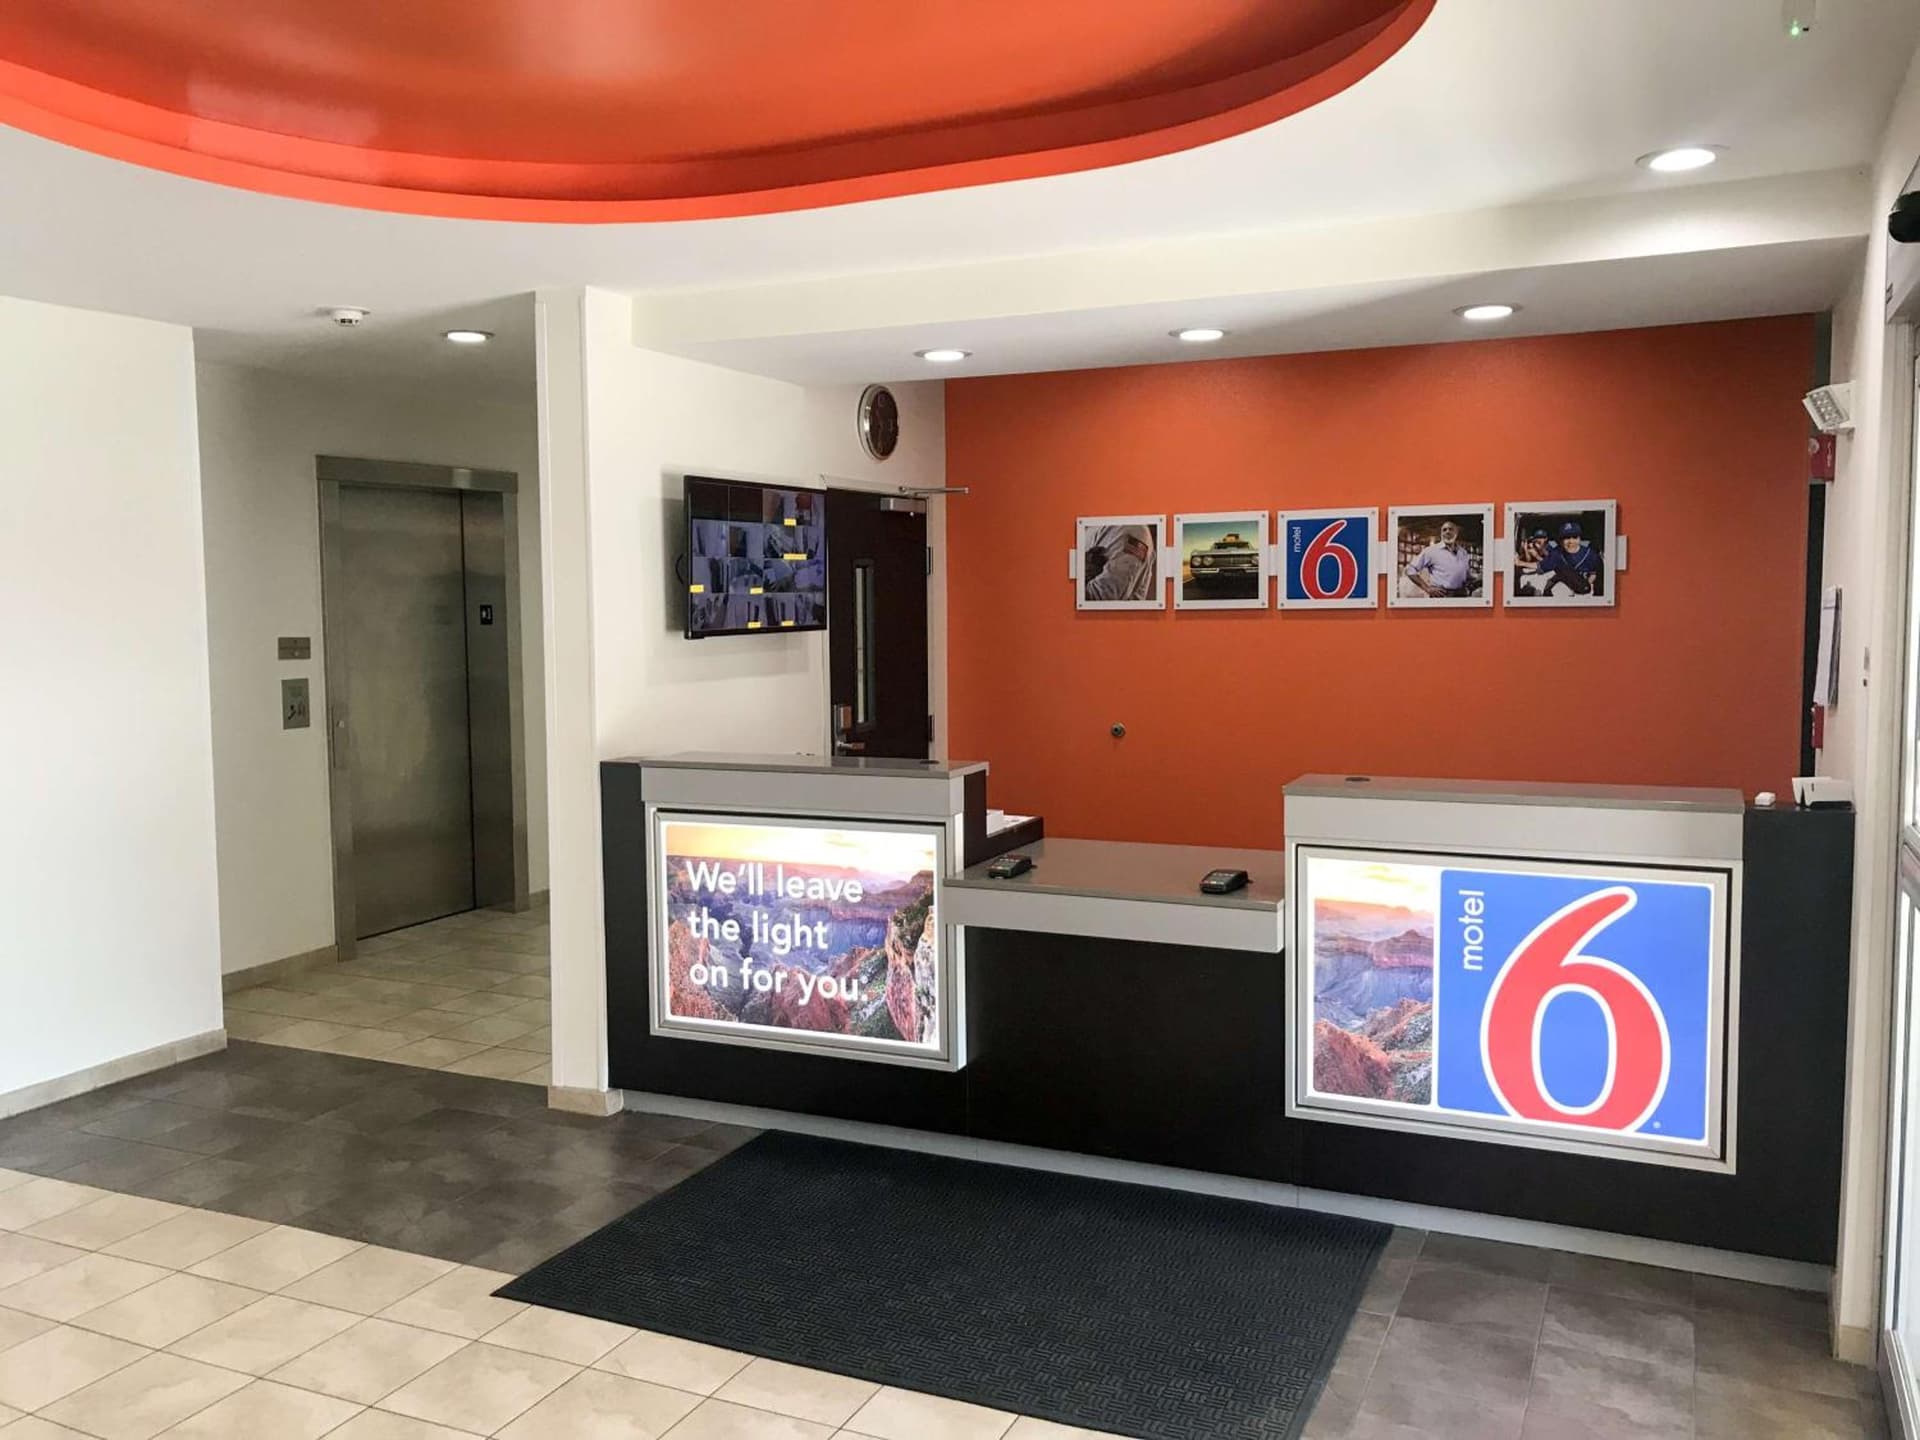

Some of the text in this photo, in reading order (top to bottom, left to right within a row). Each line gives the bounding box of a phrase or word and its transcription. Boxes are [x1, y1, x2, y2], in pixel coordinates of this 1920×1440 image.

[1292, 519, 1358, 600] motel 6
[686, 860, 864, 903] We'll leave
[687, 906, 829, 955] the light
[689, 962, 729, 988] on
[739, 957, 788, 994] for
[1458, 885, 1672, 1133] motel 6
